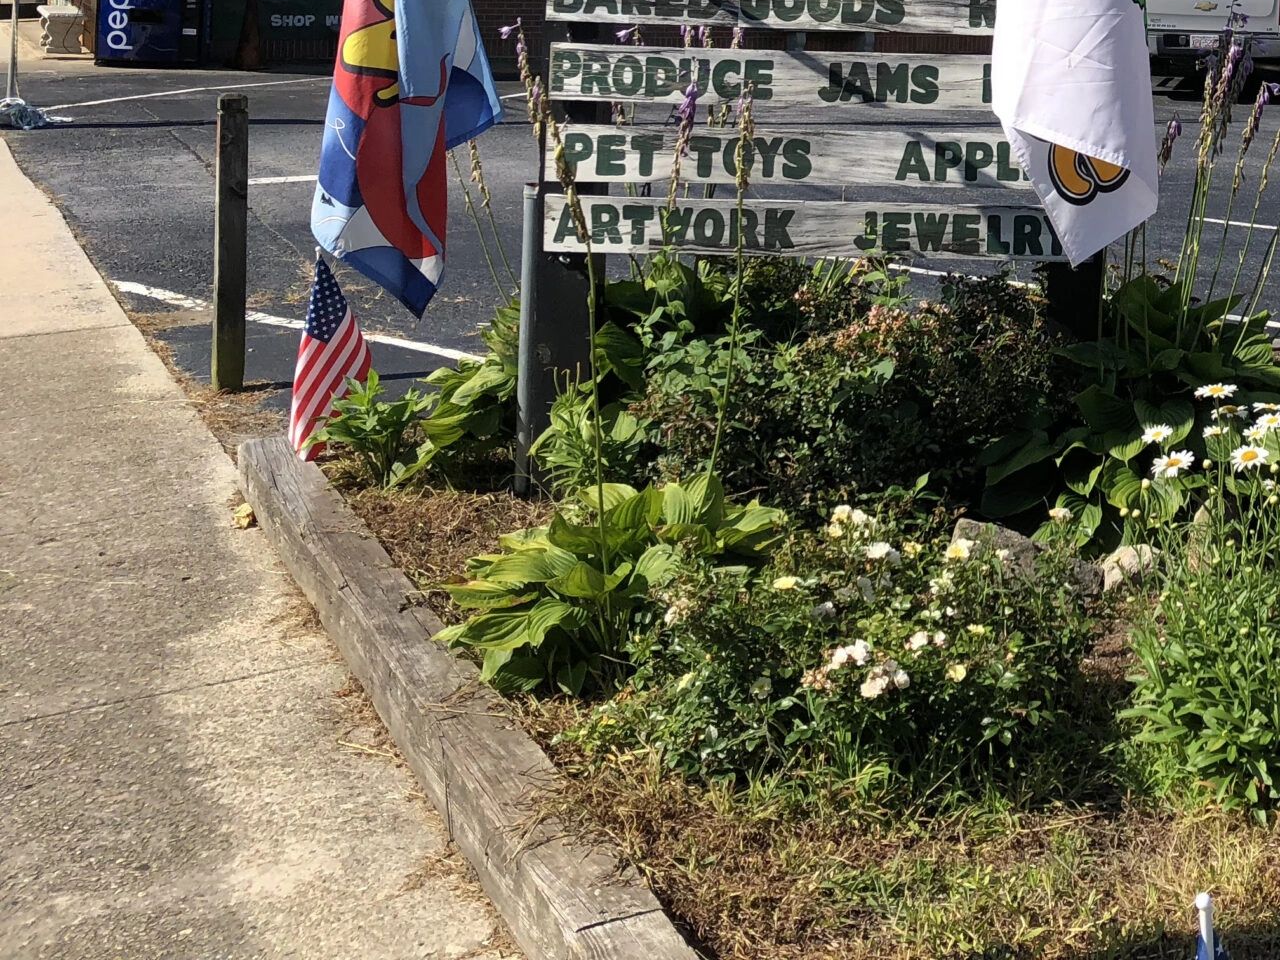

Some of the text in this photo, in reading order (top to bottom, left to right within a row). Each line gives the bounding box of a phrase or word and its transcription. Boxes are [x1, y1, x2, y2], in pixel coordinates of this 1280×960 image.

[271, 14, 315, 27] SHOP
[552, 52, 774, 100] PRODUCE
[818, 62, 939, 104] JAMS
[564, 133, 664, 178] PET
[689, 136, 812, 179] TOYS
[895, 141, 1030, 182] APPL
[553, 203, 796, 249] ARTWORK
